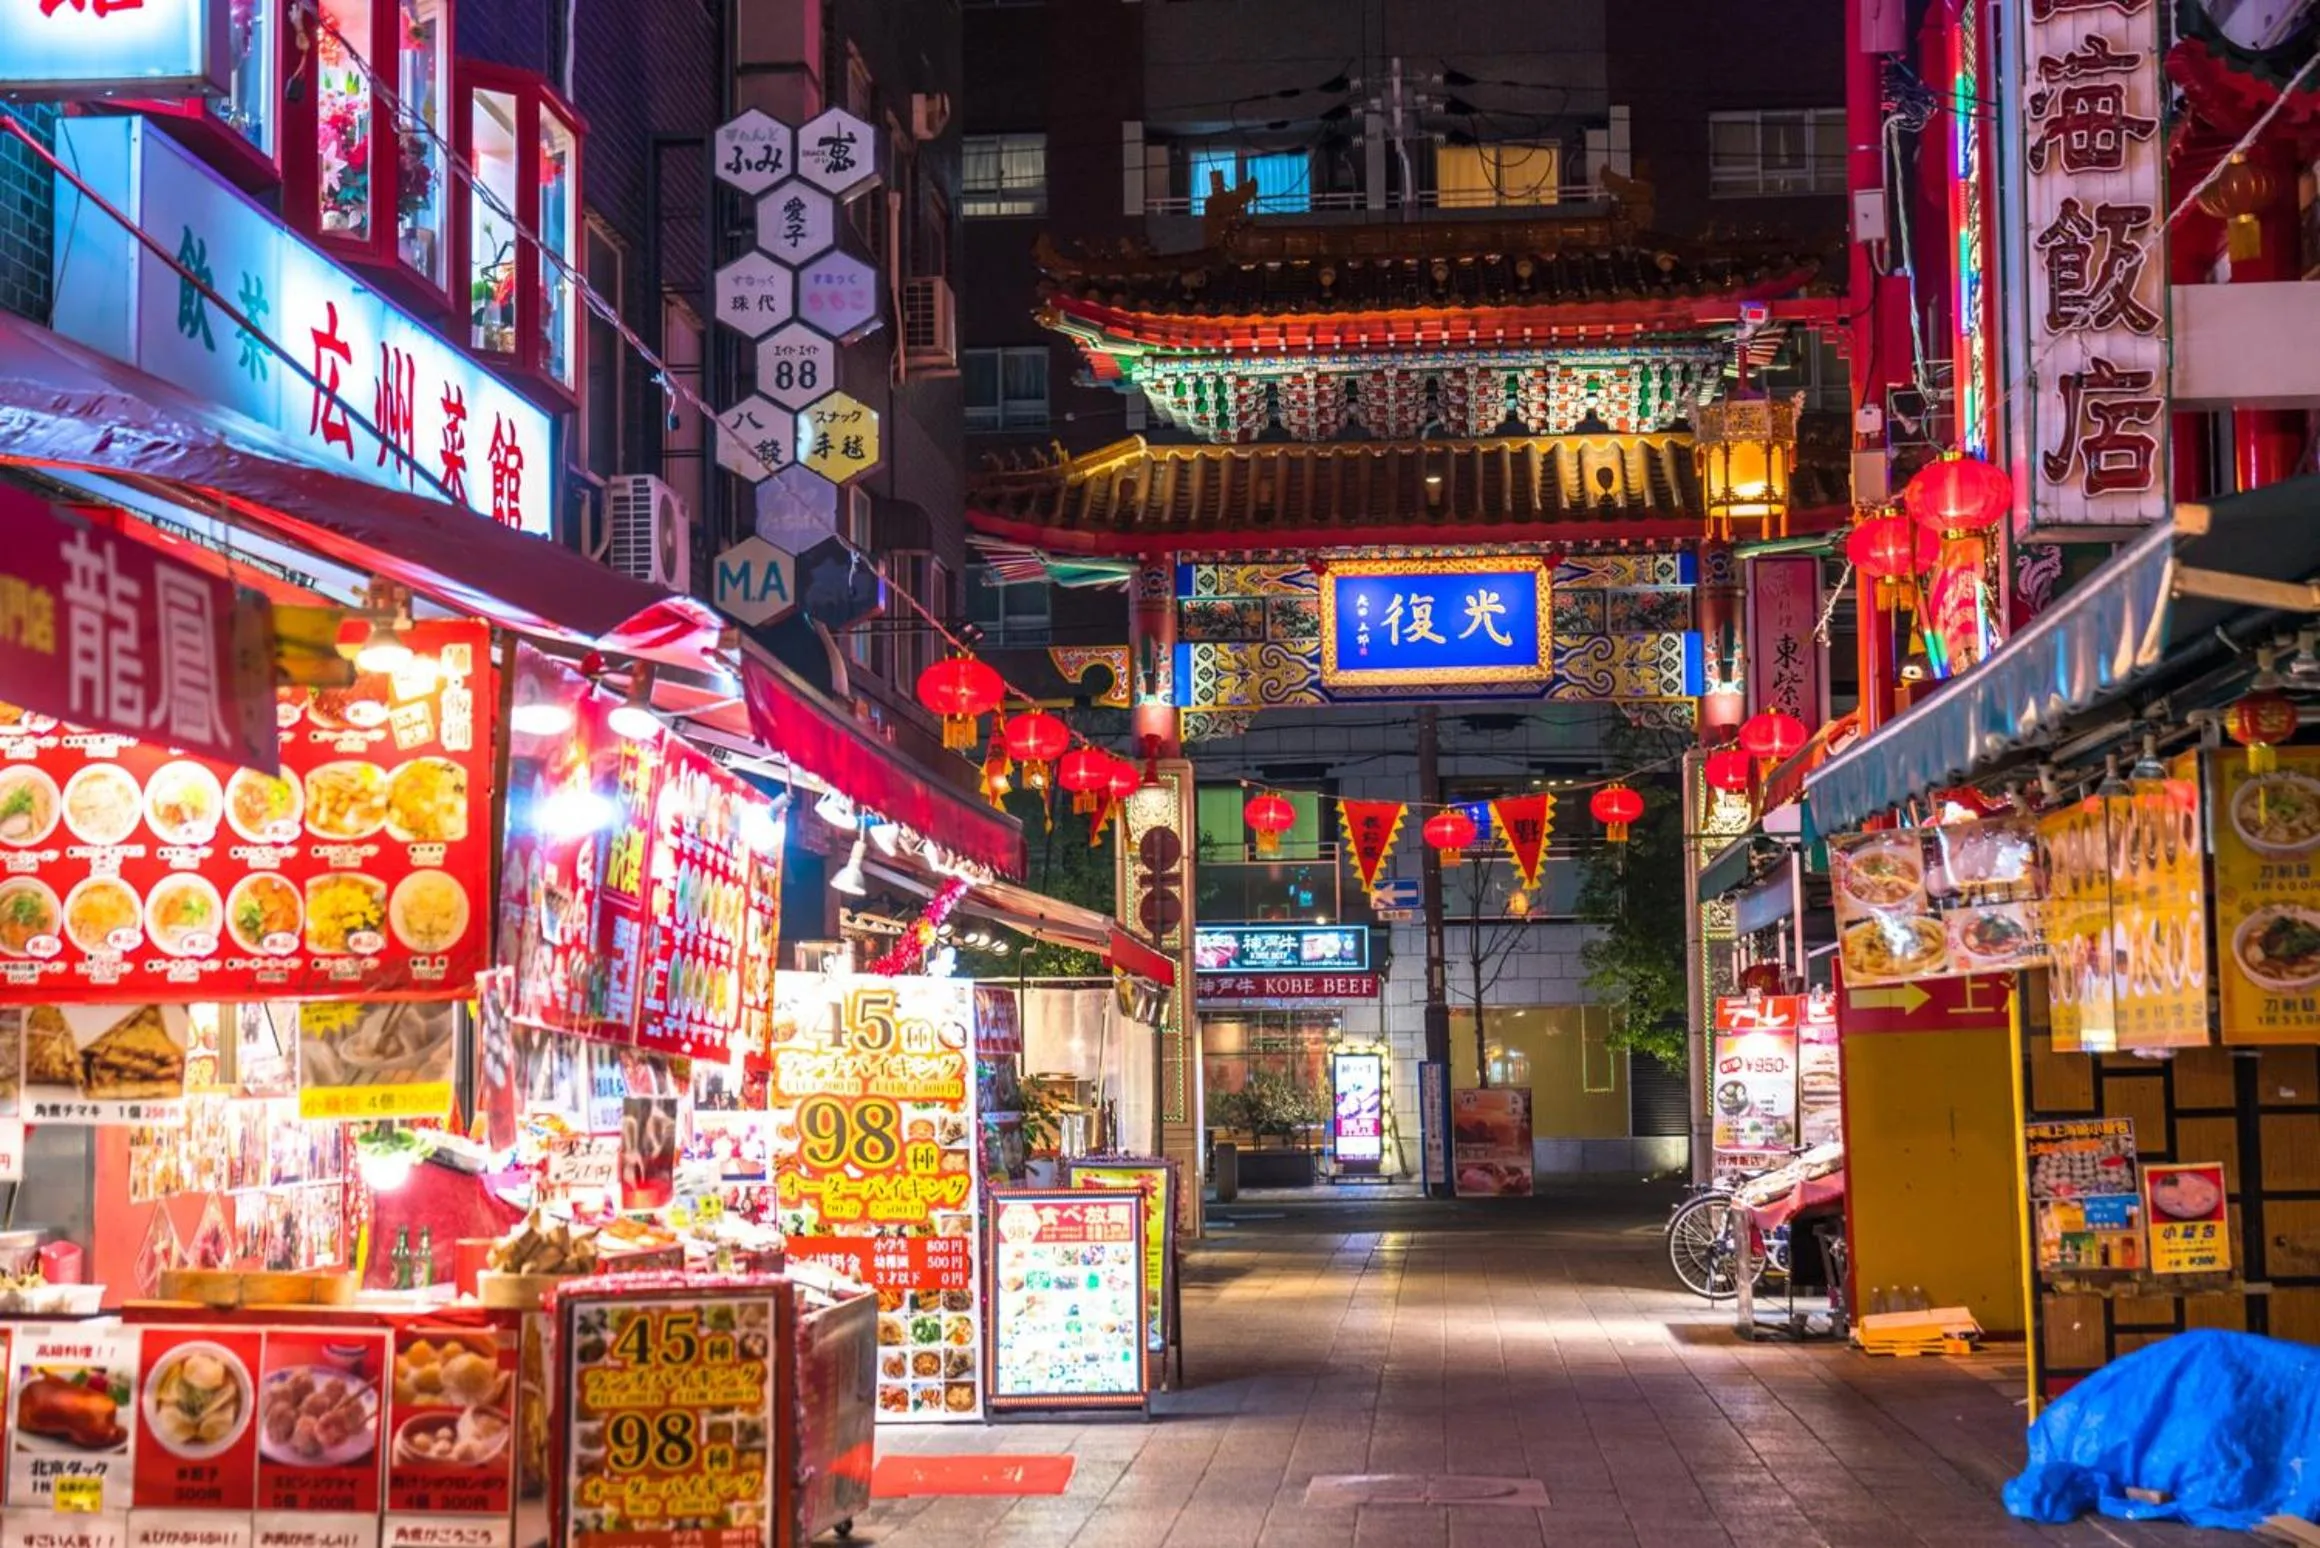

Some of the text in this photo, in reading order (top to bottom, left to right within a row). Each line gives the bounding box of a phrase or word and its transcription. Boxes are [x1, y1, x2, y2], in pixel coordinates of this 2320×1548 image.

[724, 144, 783, 175] ふみ
[783, 196, 807, 248] 愛子
[2027, 0, 2162, 497] 海飯店
[731, 275, 775, 287] すなっく
[731, 294, 776, 312] 珠代
[177, 224, 524, 532] 飲茶 広州菜館
[775, 360, 817, 390] 88
[815, 411, 862, 424] スナック
[1242, 933, 1299, 953] 神戸牛
[1196, 978, 1373, 996] 神戸牛 KOBE BEEF
[813, 996, 895, 1051] 45
[34, 1105, 101, 1118] 角煮チマキ
[118, 1105, 141, 1119] 1個
[805, 1102, 896, 1165] 98
[781, 1172, 964, 1199] オーダーバイキング
[873, 1238, 909, 1252] 小学生
[926, 1255, 963, 1268] 500円
[940, 1272, 964, 1286] 0円
[612, 1316, 699, 1365] 45
[610, 1411, 695, 1471] 98
[31, 1459, 109, 1478] 北京ダック
